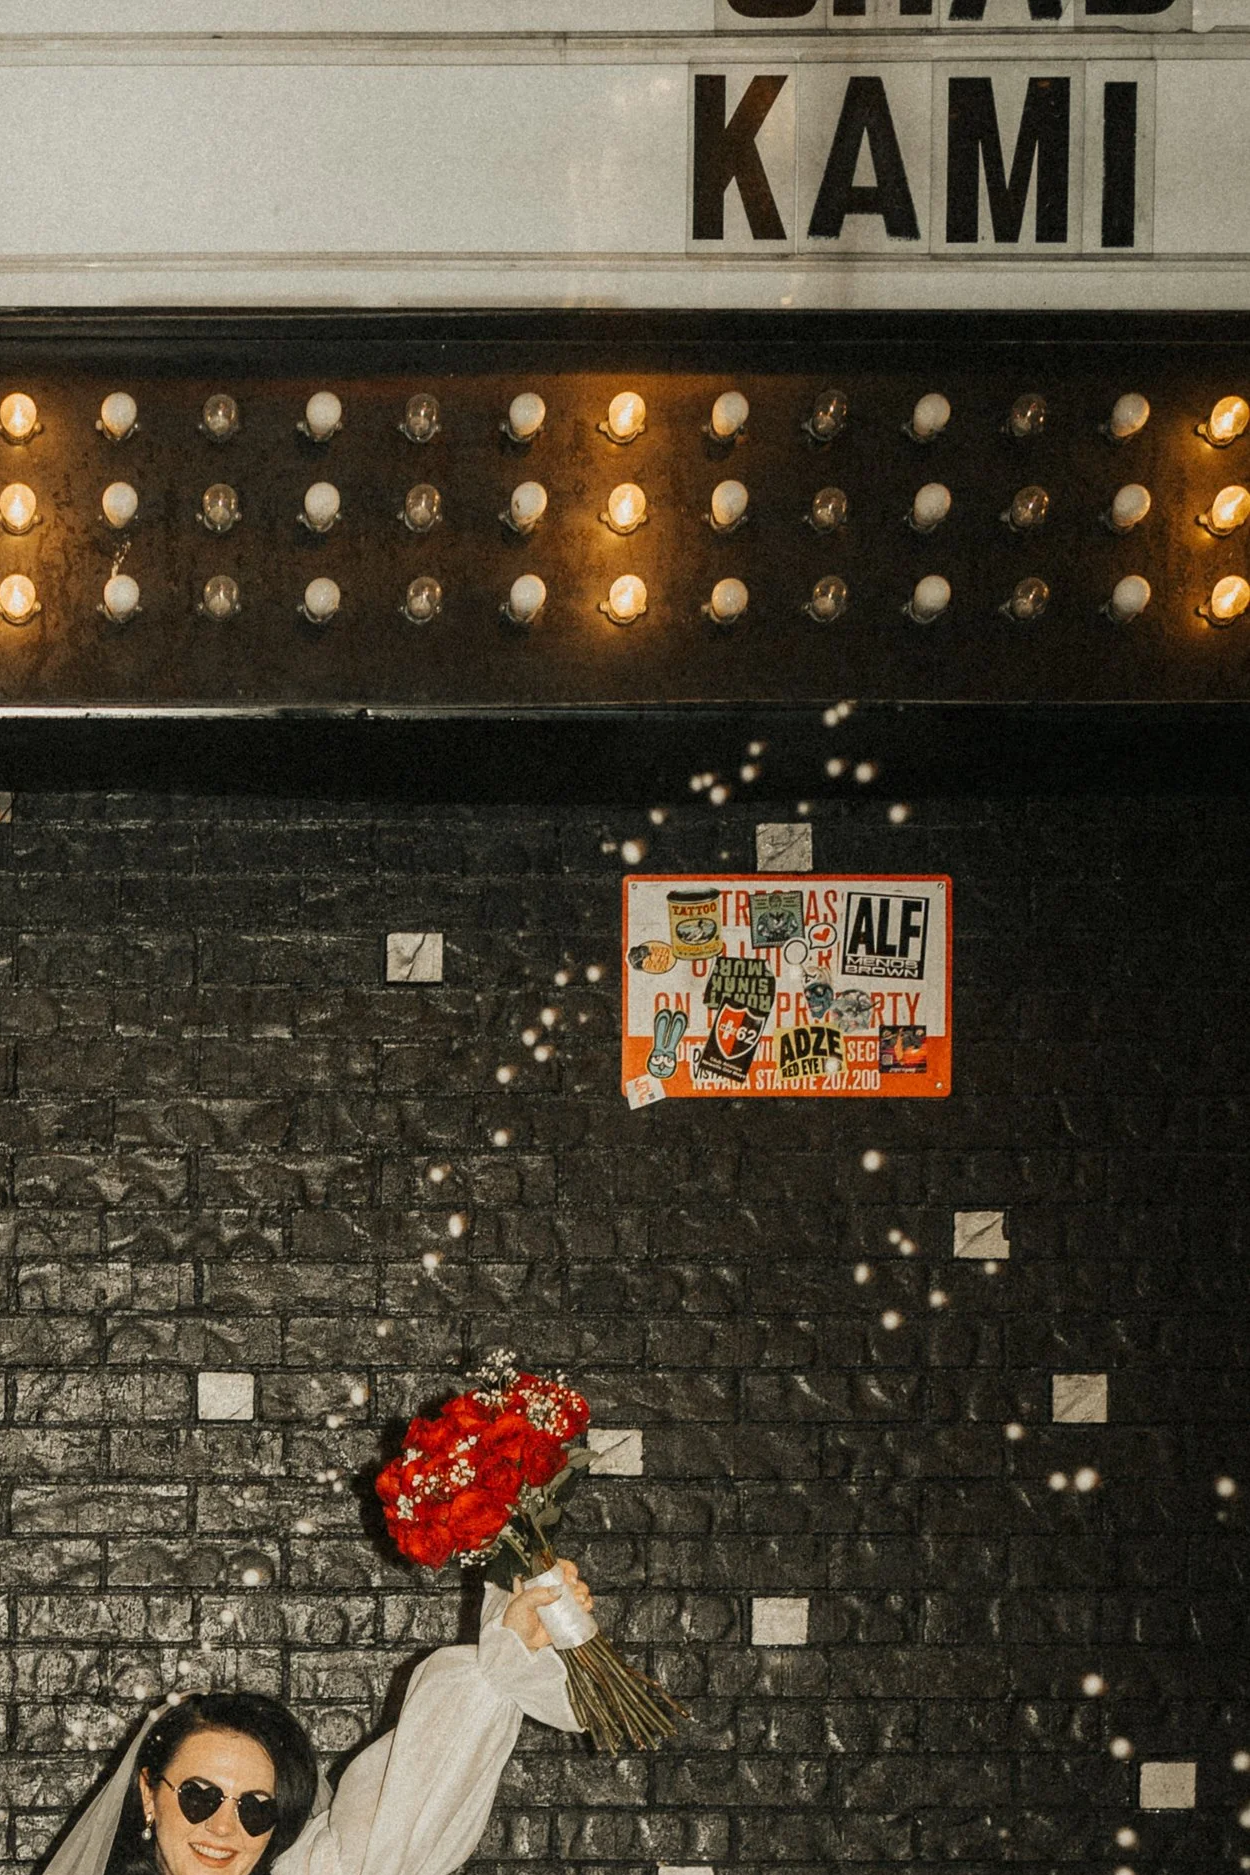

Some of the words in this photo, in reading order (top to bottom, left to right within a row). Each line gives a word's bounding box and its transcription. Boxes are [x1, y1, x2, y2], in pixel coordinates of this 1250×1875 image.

[692, 74, 1139, 248] KAMI
[671, 902, 717, 917] TATTOO
[847, 896, 922, 958] ALF
[844, 965, 918, 978] BROWN
[780, 1026, 844, 1069] ADZE
[781, 1063, 800, 1079] RED
[801, 1058, 819, 1076] EYE
